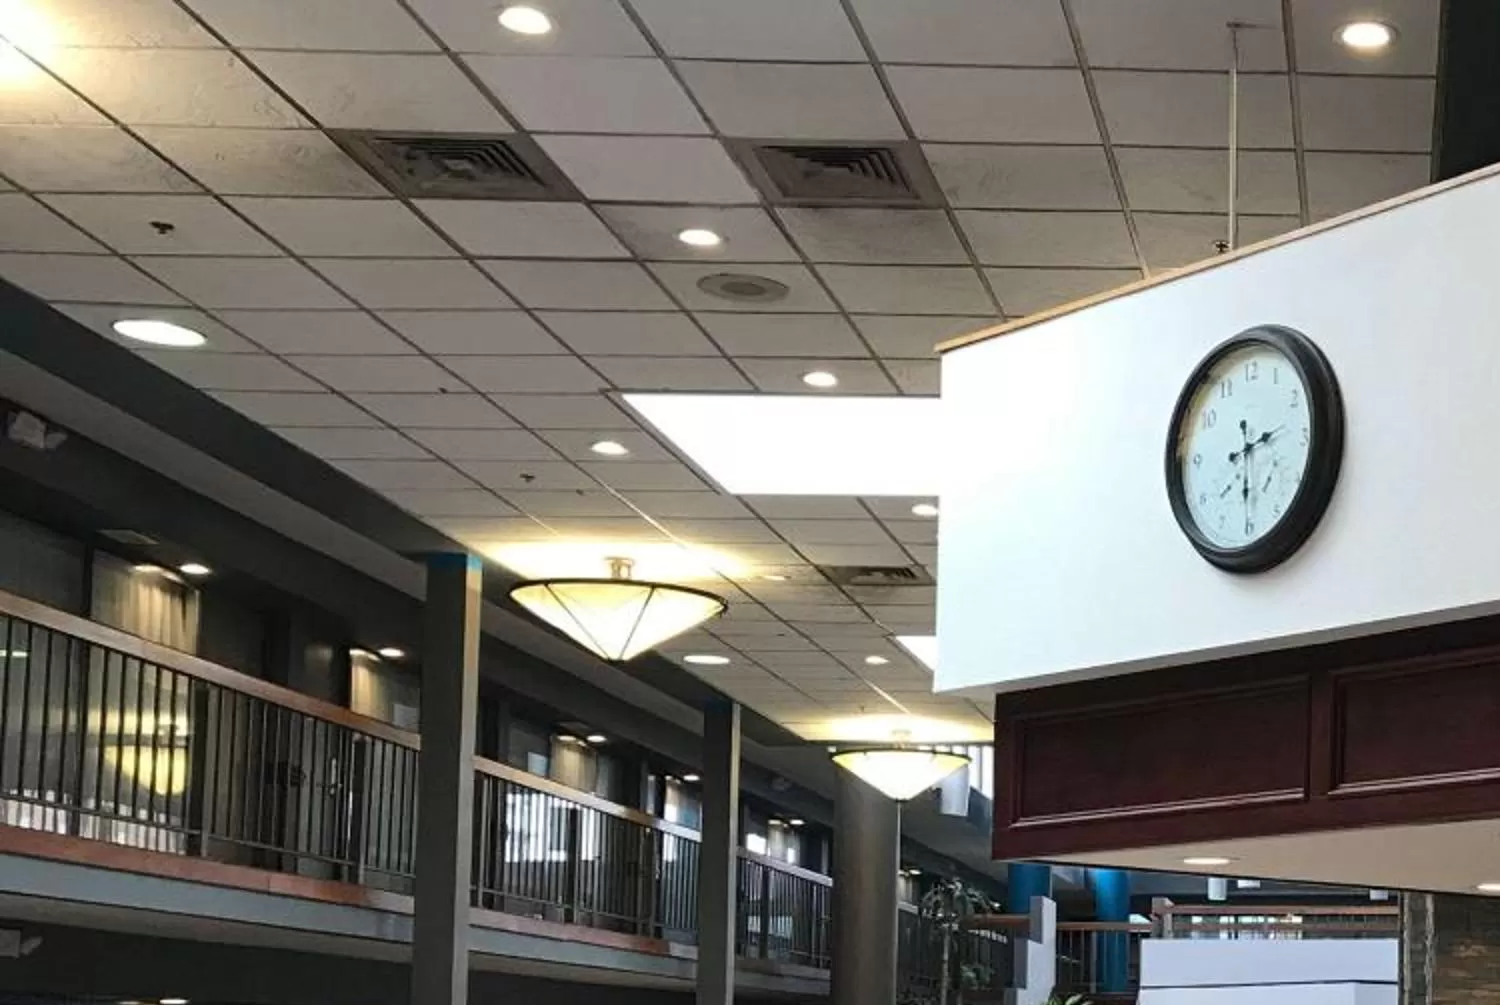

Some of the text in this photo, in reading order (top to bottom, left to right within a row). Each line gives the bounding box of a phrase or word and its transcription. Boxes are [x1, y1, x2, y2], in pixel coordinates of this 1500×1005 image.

[1244, 360, 1258, 383] 12
[1272, 366, 1279, 385] 1
[1220, 379, 1233, 399] 11
[1289, 389, 1299, 409] 2
[1202, 408, 1217, 431] 10
